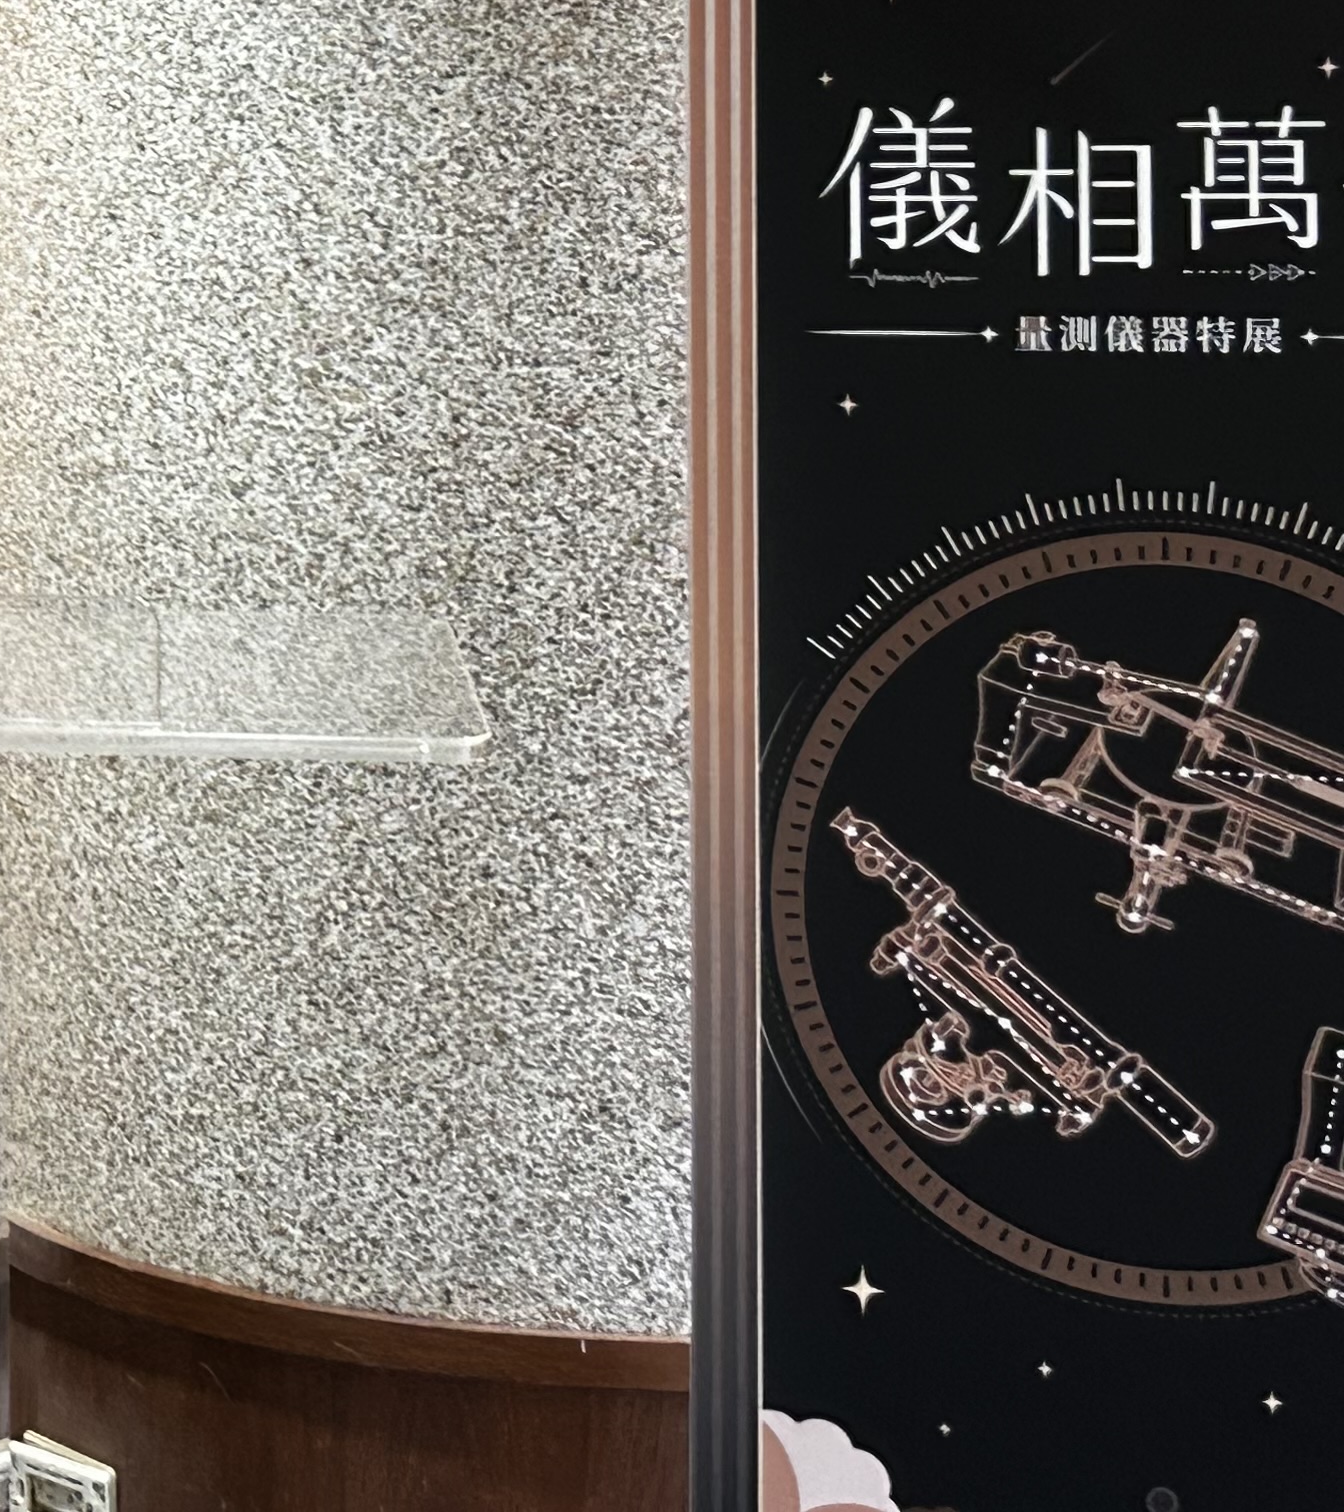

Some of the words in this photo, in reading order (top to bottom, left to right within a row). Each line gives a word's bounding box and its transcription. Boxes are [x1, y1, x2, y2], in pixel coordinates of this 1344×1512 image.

[819, 96, 1326, 278] 儀相萬
[1015, 315, 1282, 354] 量測儀器特展
